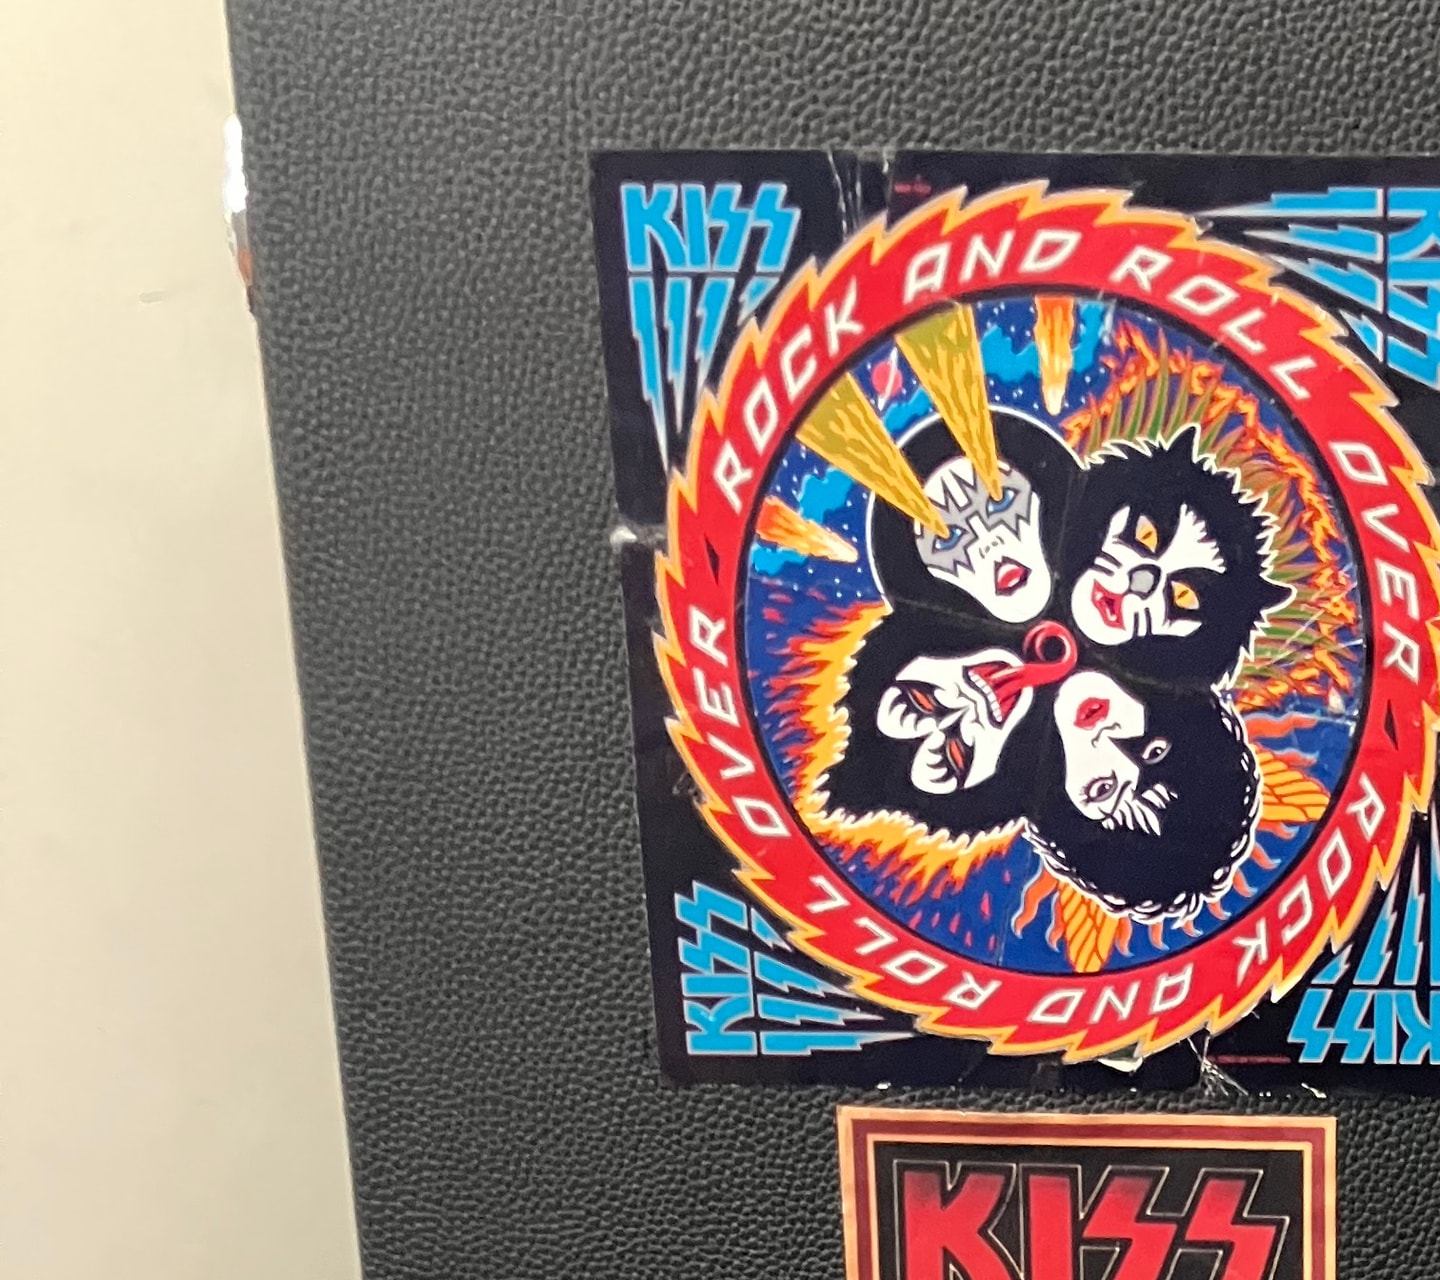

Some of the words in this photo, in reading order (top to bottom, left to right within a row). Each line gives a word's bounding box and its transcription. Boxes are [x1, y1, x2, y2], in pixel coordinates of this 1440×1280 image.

[620, 182, 801, 272] KISS
[713, 277, 863, 514] ROCK
[902, 229, 1082, 304] AND
[1109, 245, 1318, 400] ROLL
[1328, 440, 1421, 686] OVER
[689, 605, 792, 839] OVER
[805, 874, 1001, 1010] ROLL
[1232, 771, 1387, 986] ROCK
[674, 880, 758, 1057] KISS
[1029, 961, 1194, 1025] AND
